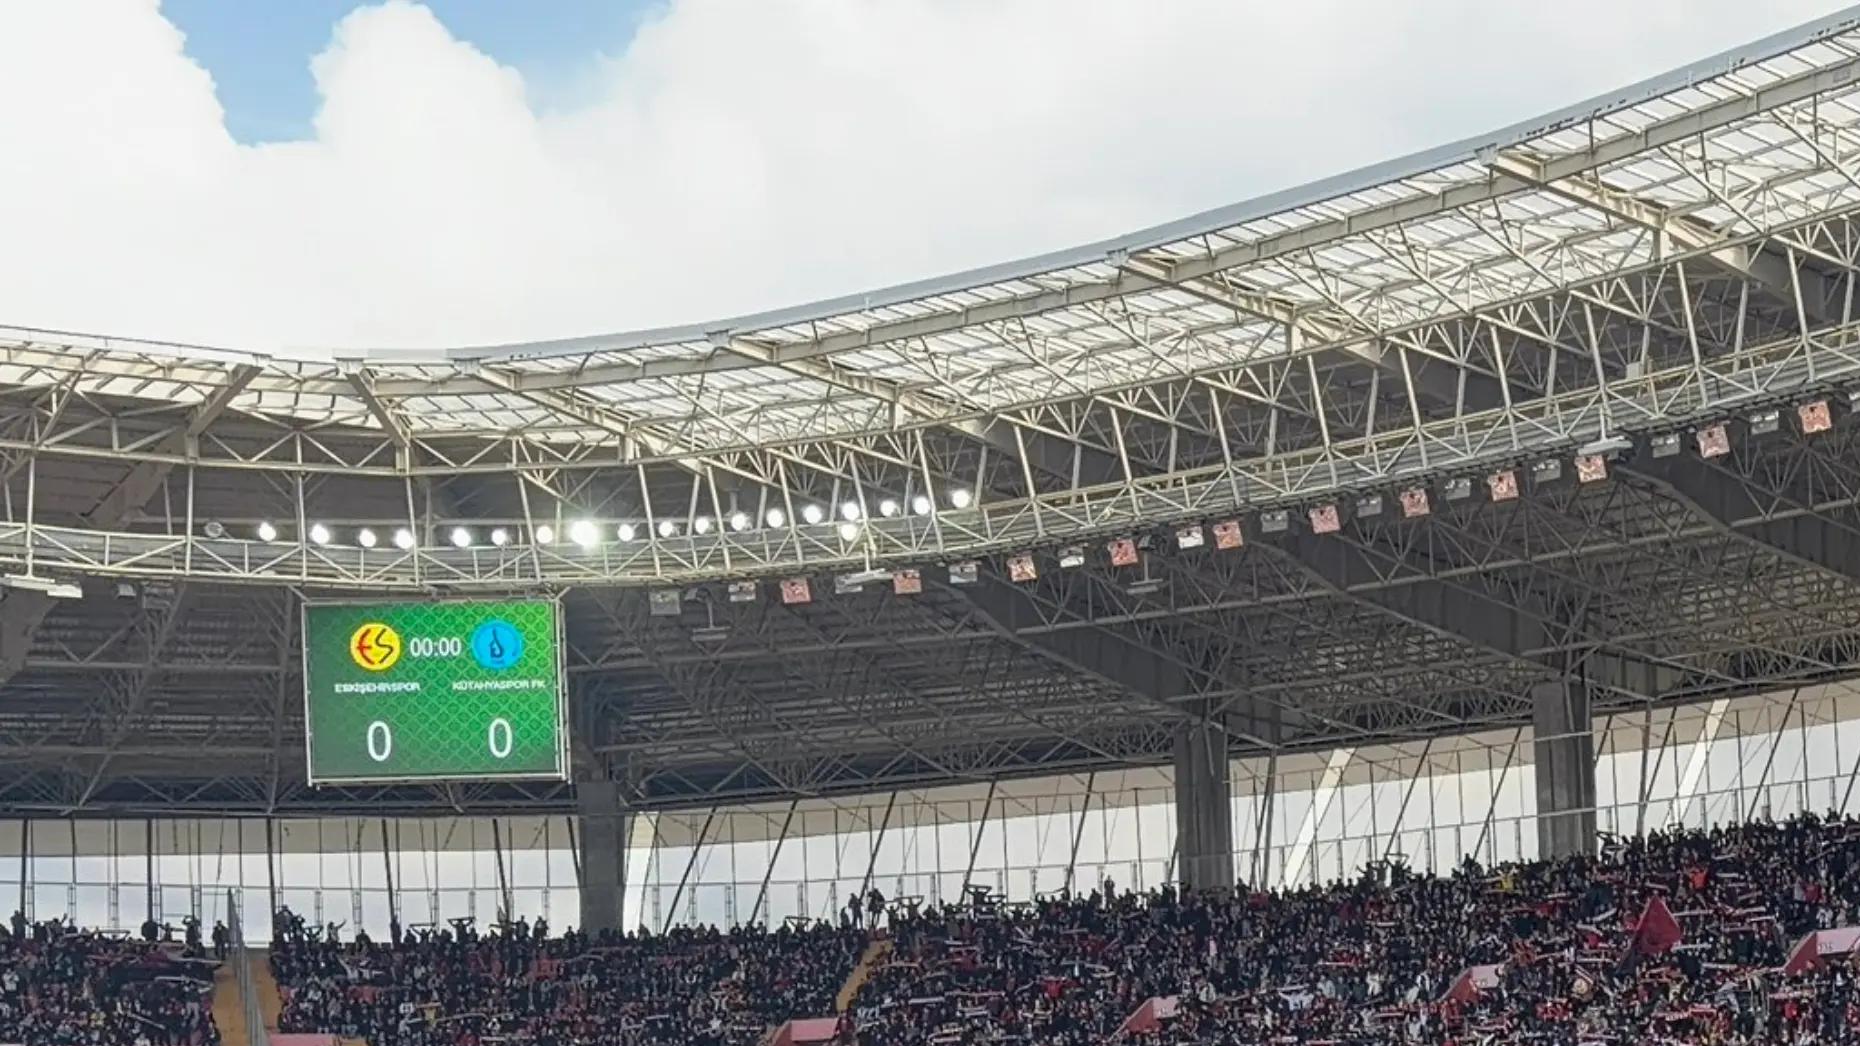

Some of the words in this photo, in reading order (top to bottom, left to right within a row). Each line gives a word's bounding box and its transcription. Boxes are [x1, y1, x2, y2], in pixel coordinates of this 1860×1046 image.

[409, 637, 462, 657] 00:00
[367, 721, 392, 761] 0
[488, 718, 513, 758] 0
